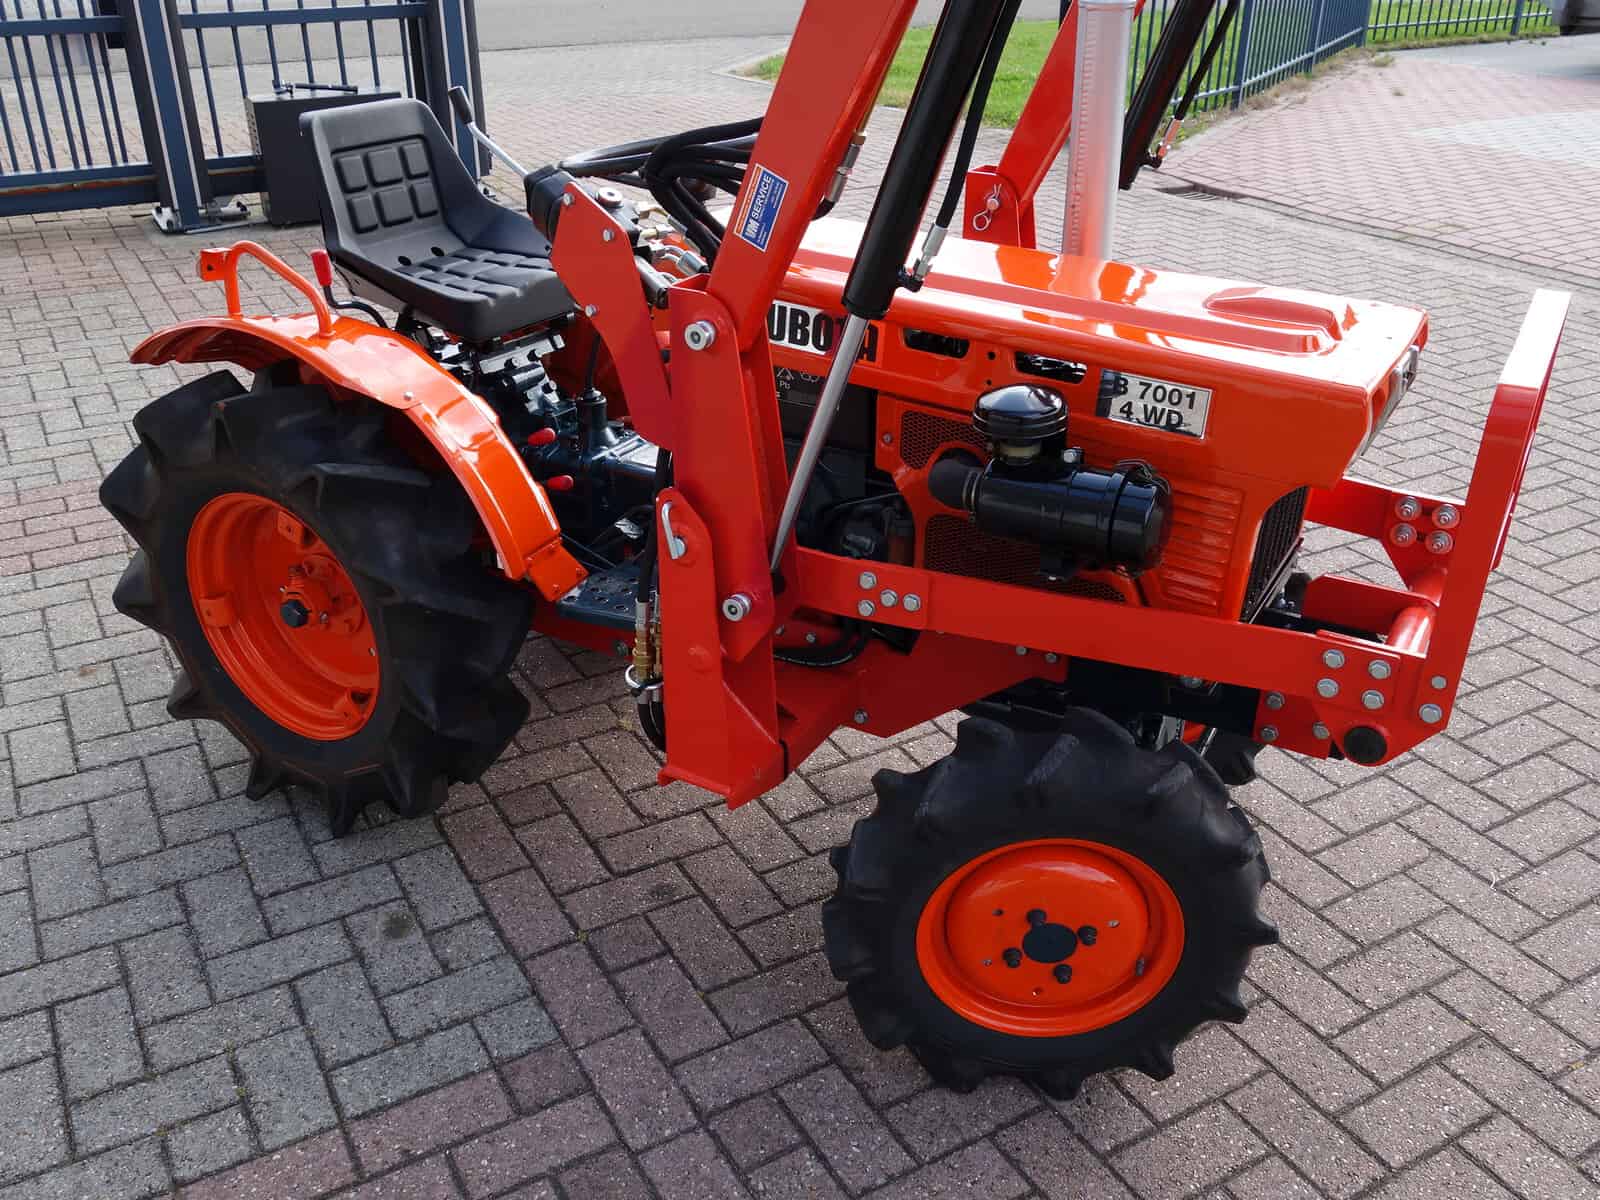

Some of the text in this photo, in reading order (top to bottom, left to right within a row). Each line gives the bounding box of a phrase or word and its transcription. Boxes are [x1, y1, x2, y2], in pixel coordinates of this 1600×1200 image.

[751, 175, 773, 220] SERVICE
[779, 380, 791, 389] Pb
[1138, 381, 1196, 410] 7001
